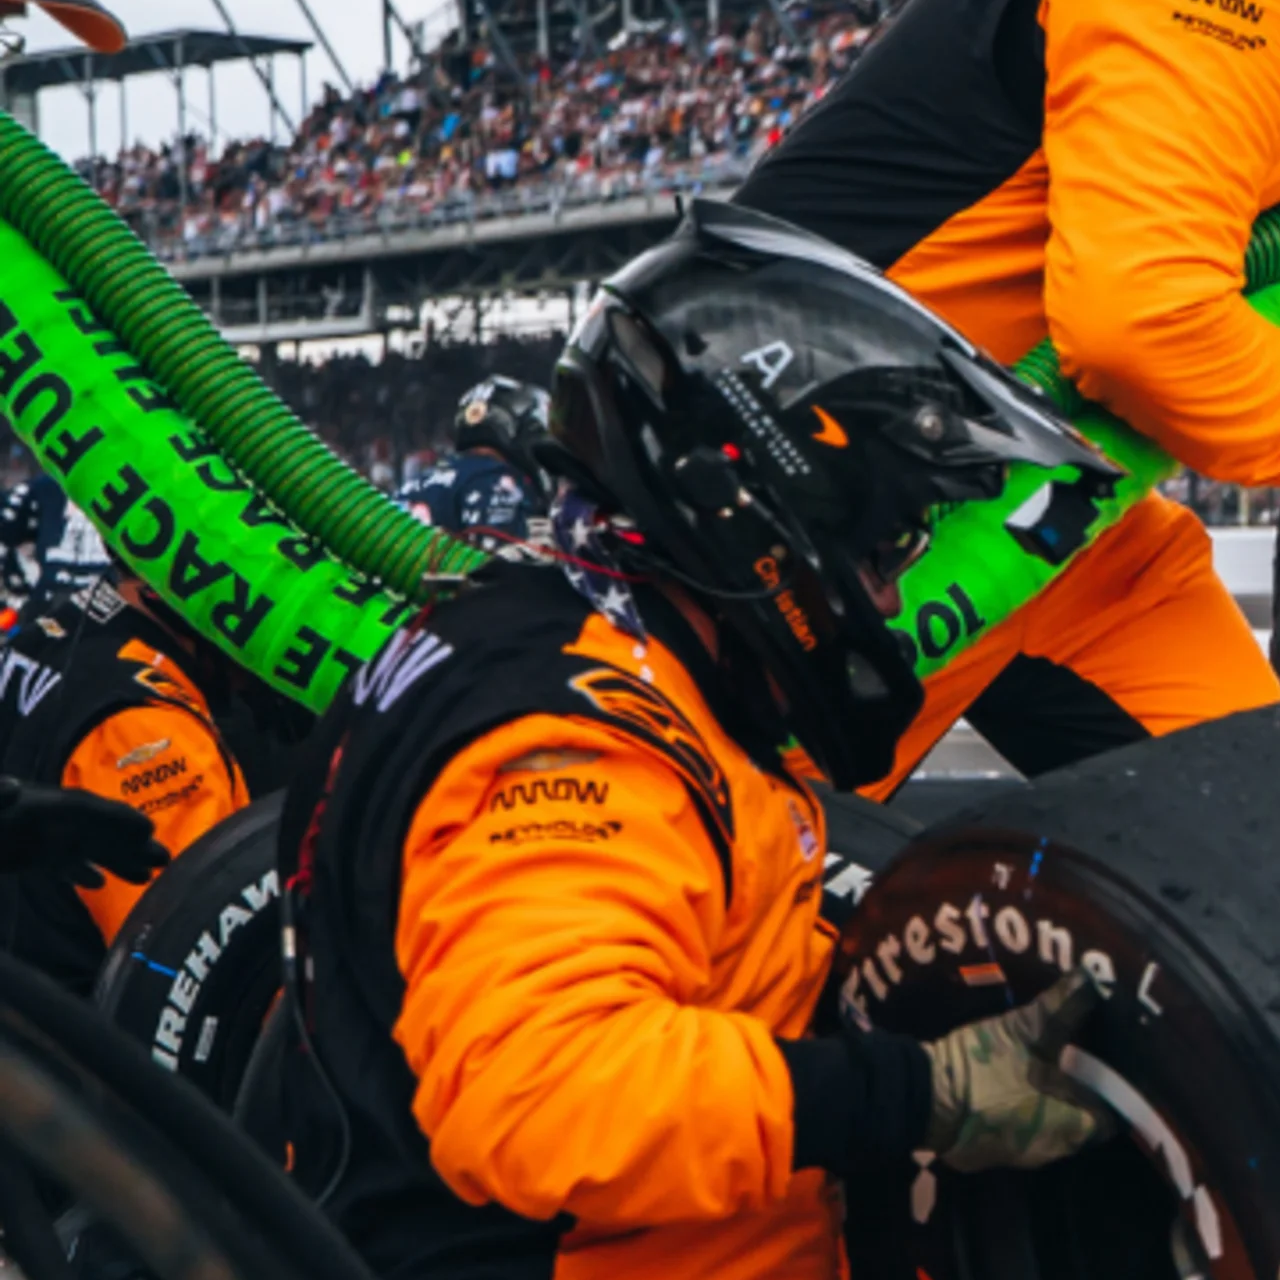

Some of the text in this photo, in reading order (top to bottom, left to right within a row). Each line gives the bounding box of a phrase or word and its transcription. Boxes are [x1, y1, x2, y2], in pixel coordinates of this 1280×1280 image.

[90, 464, 277, 649] RACE
[152, 869, 281, 1072] IREHAW
[839, 895, 1116, 1032] Firestone
